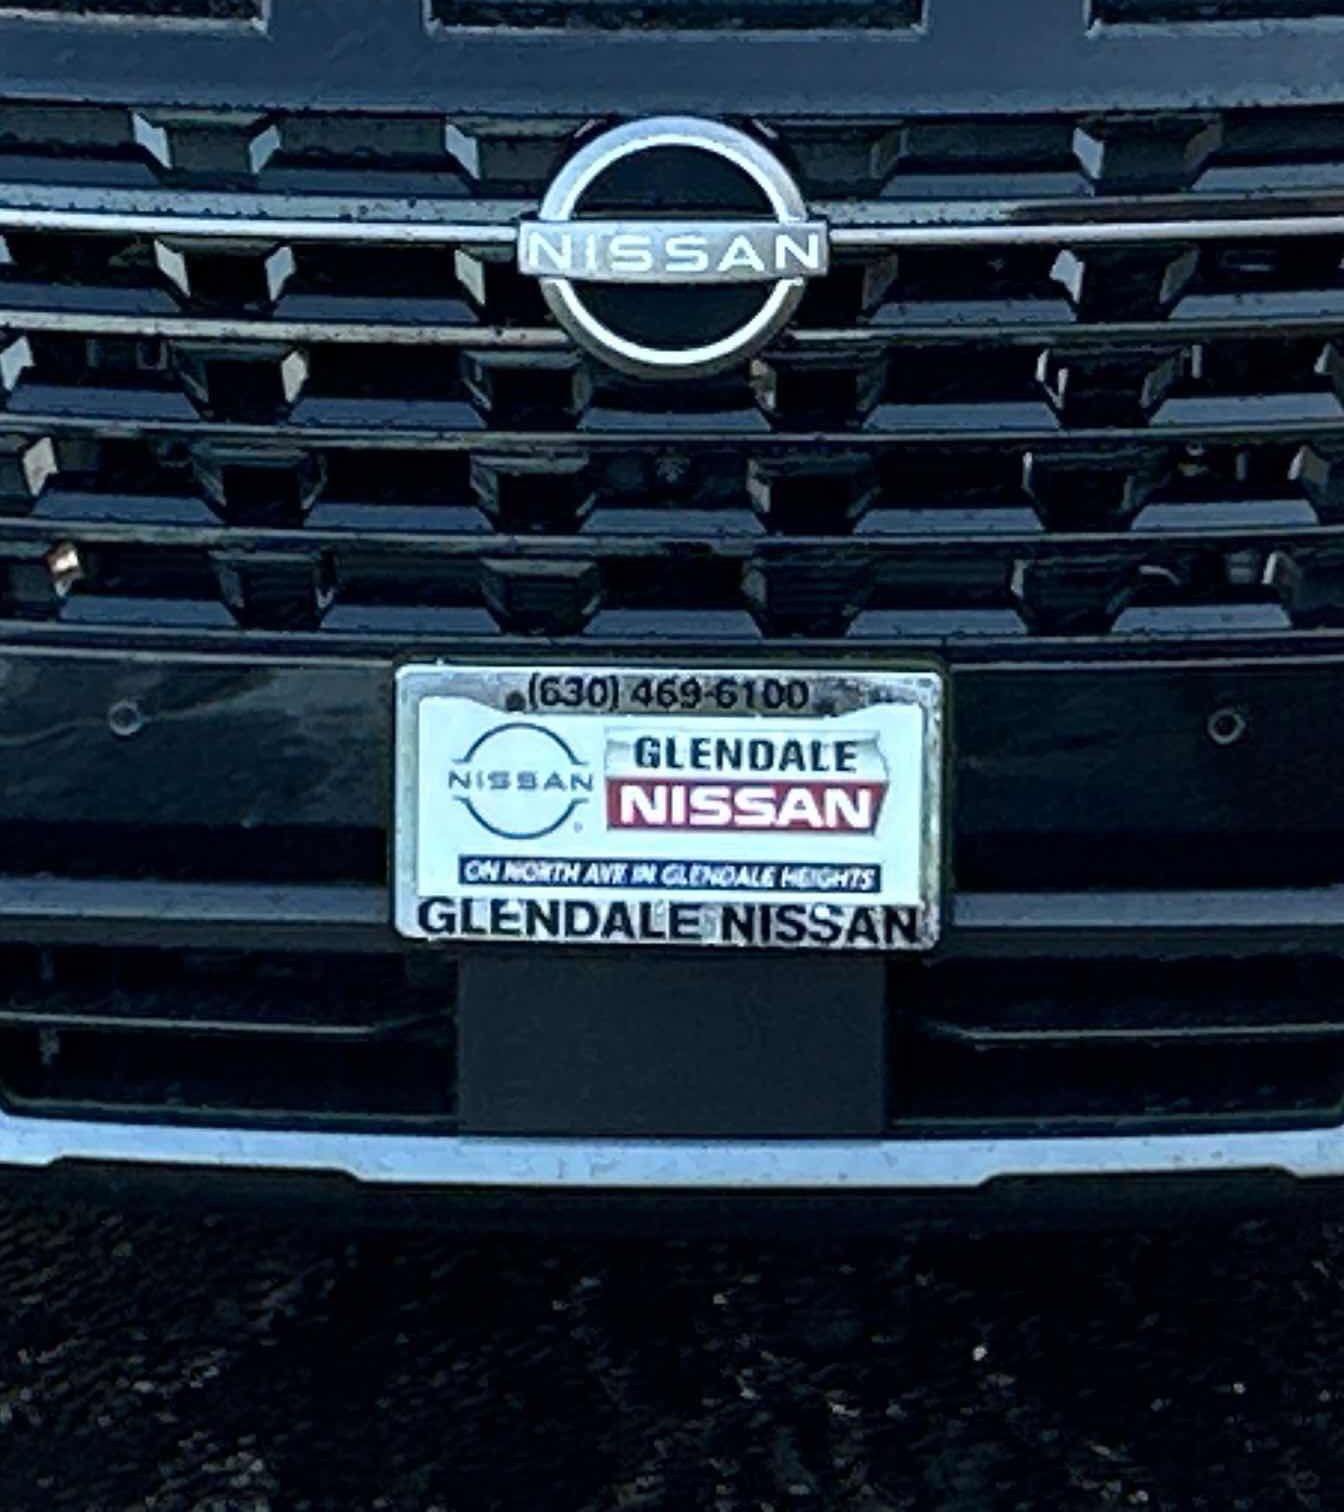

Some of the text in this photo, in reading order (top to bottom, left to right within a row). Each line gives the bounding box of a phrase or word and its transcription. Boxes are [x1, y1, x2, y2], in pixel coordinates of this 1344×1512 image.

[527, 232, 819, 272] NISSAN
[527, 674, 810, 712] (630) 469-6100
[633, 735, 858, 773] GLENDALE
[448, 769, 594, 792] NISSAN
[619, 784, 874, 830] NISSAN
[464, 858, 876, 891] ON NORTH AVE IN GLENDALE HEIGHTS
[417, 896, 920, 946] GLENDALE NISSAN
